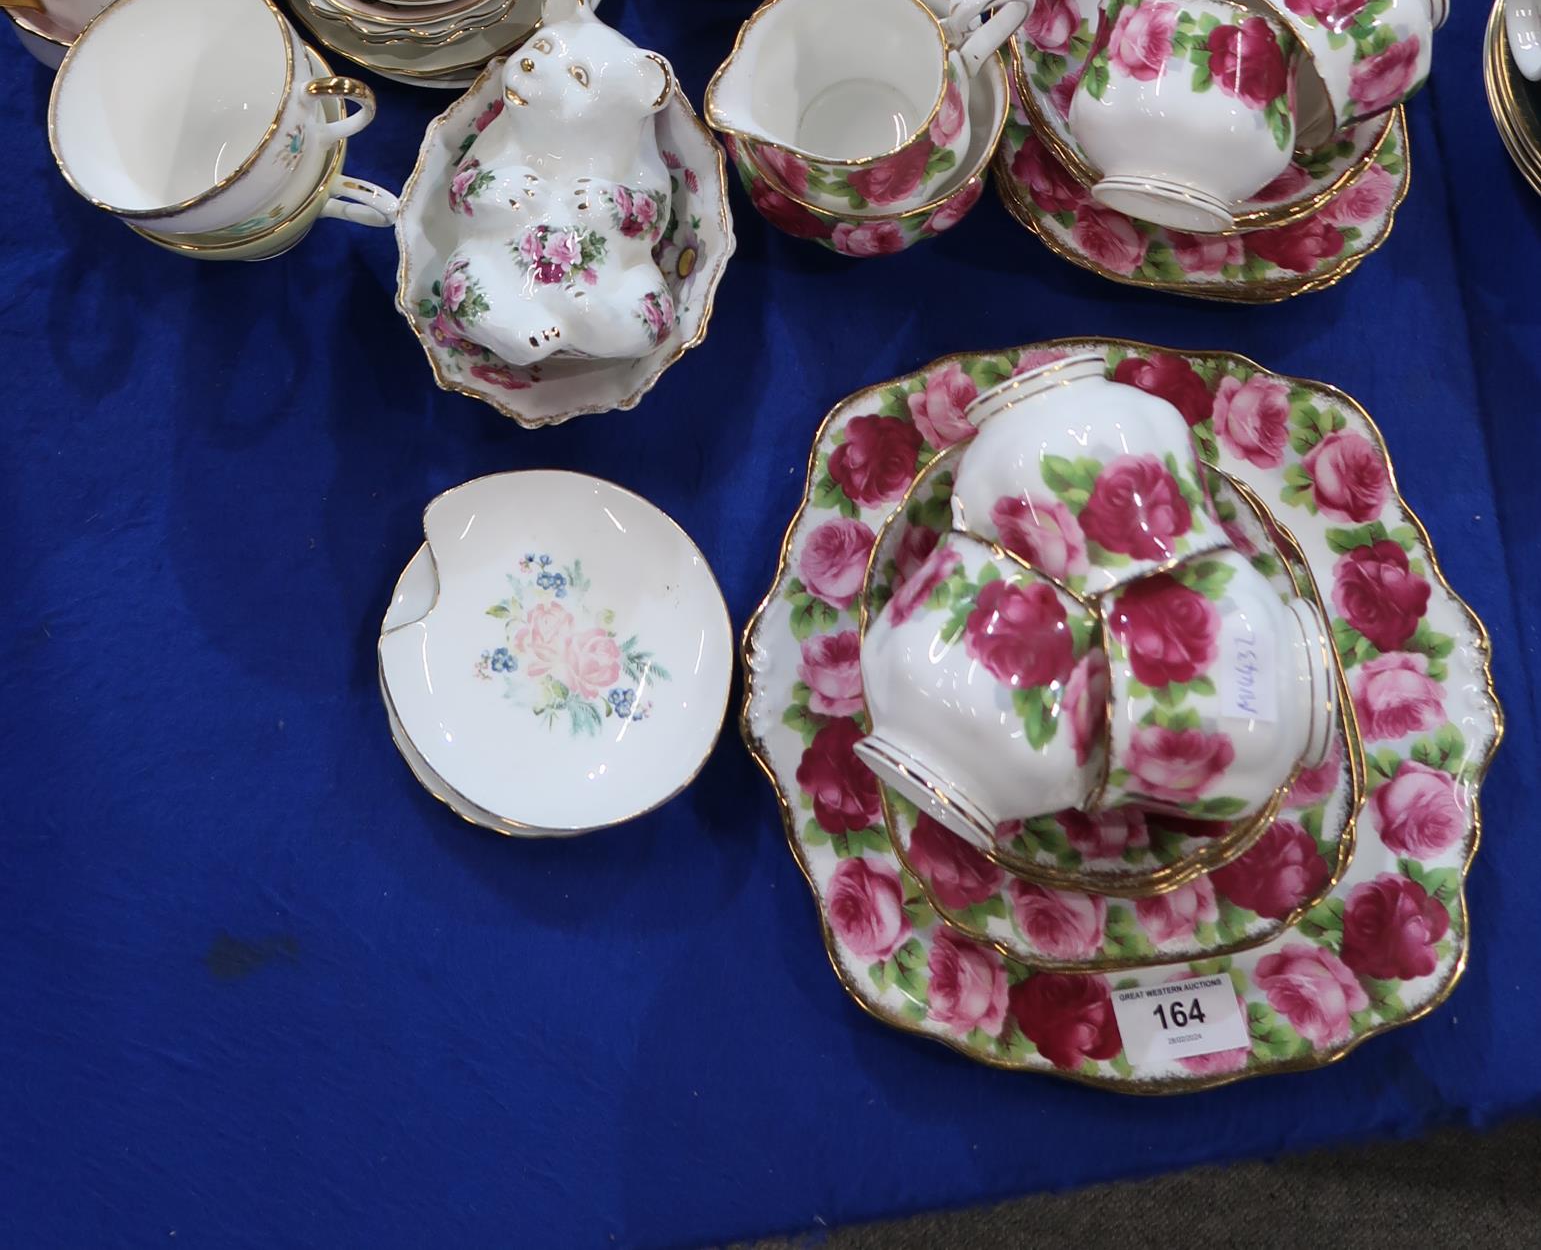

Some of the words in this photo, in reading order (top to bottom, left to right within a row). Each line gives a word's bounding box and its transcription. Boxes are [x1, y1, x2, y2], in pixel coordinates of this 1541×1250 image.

[1119, 991, 1144, 1001] GREAT
[1146, 984, 1182, 997] WESTERN
[1183, 979, 1222, 991] AUCTIONS
[1153, 998, 1206, 1029] 164
